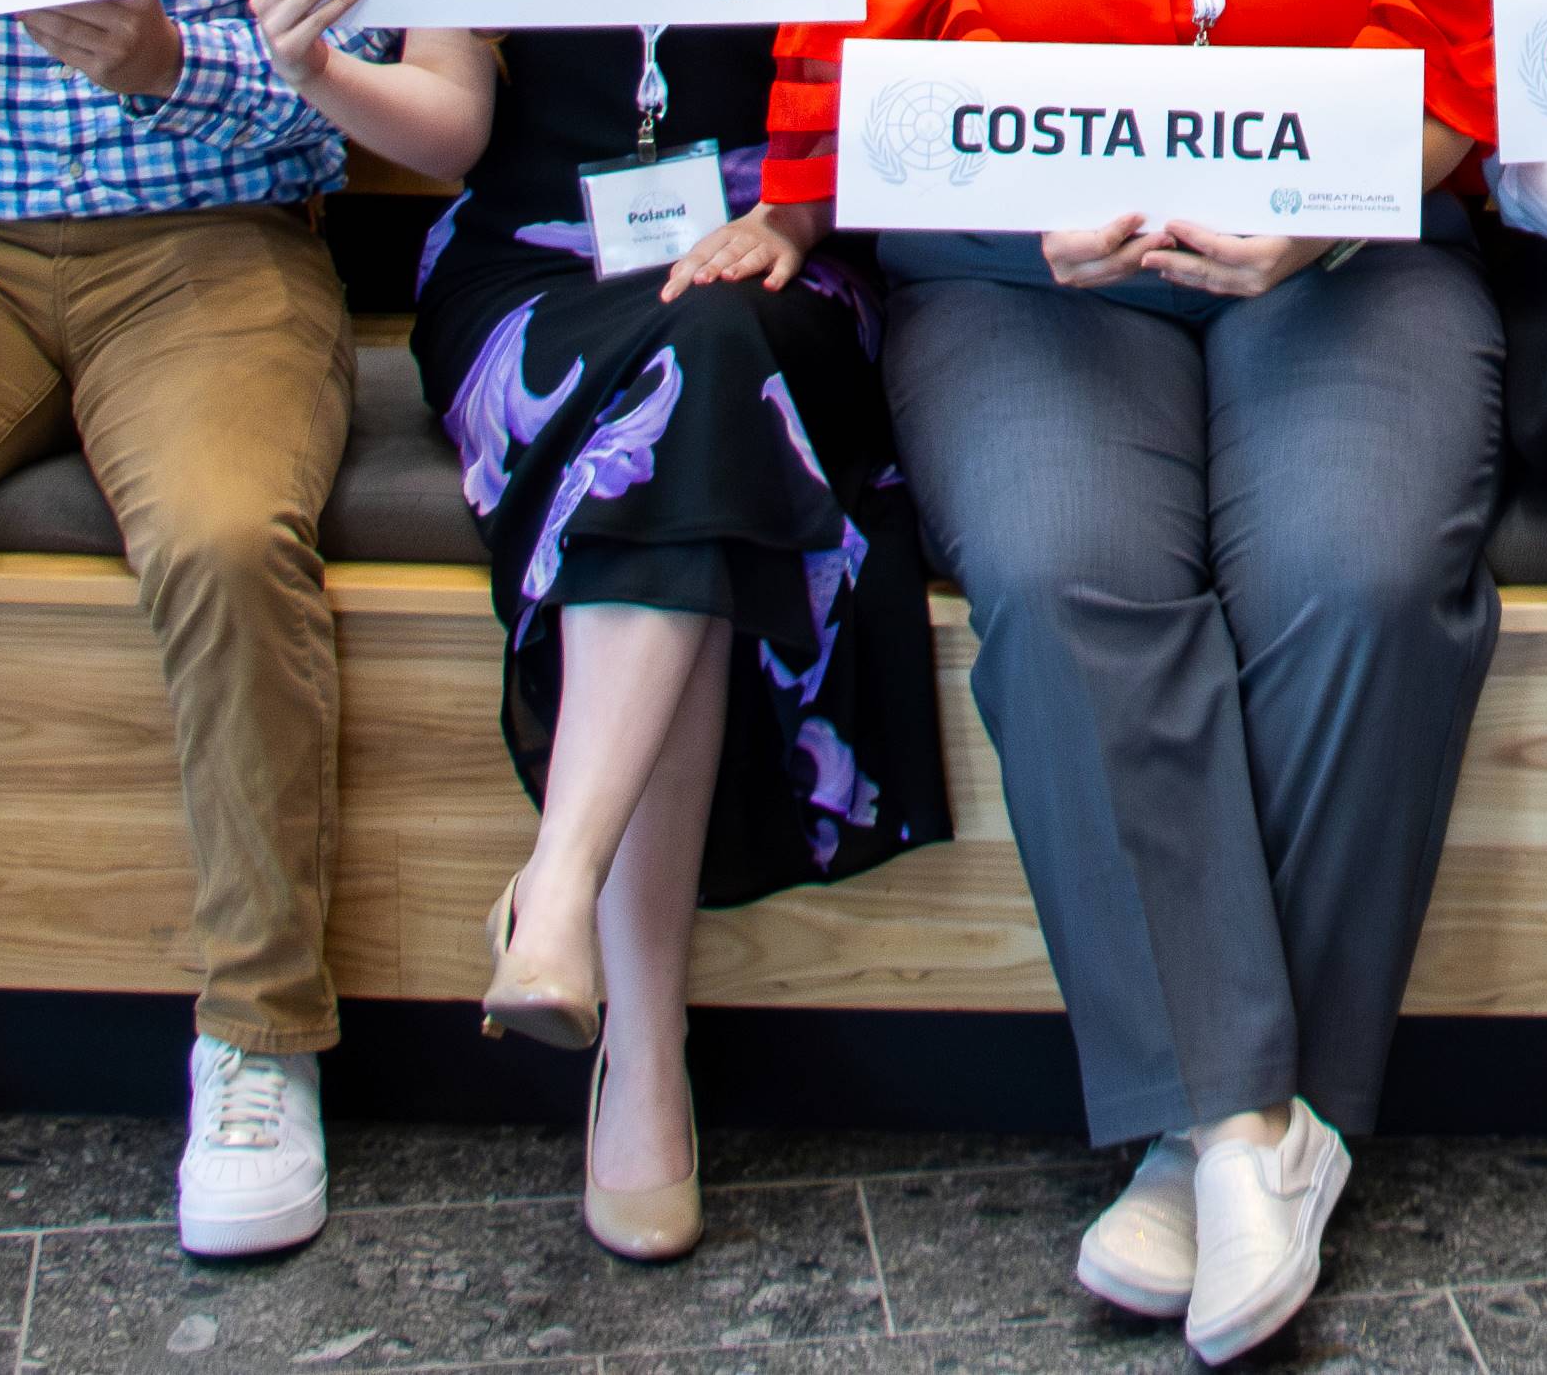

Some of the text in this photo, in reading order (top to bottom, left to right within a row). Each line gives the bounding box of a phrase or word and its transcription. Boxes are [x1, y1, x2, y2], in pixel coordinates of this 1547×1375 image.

[952, 104, 1310, 161] COSTA RICA
[1308, 193, 1396, 203] GREAT PLAINS
[627, 203, 687, 225] Poland
